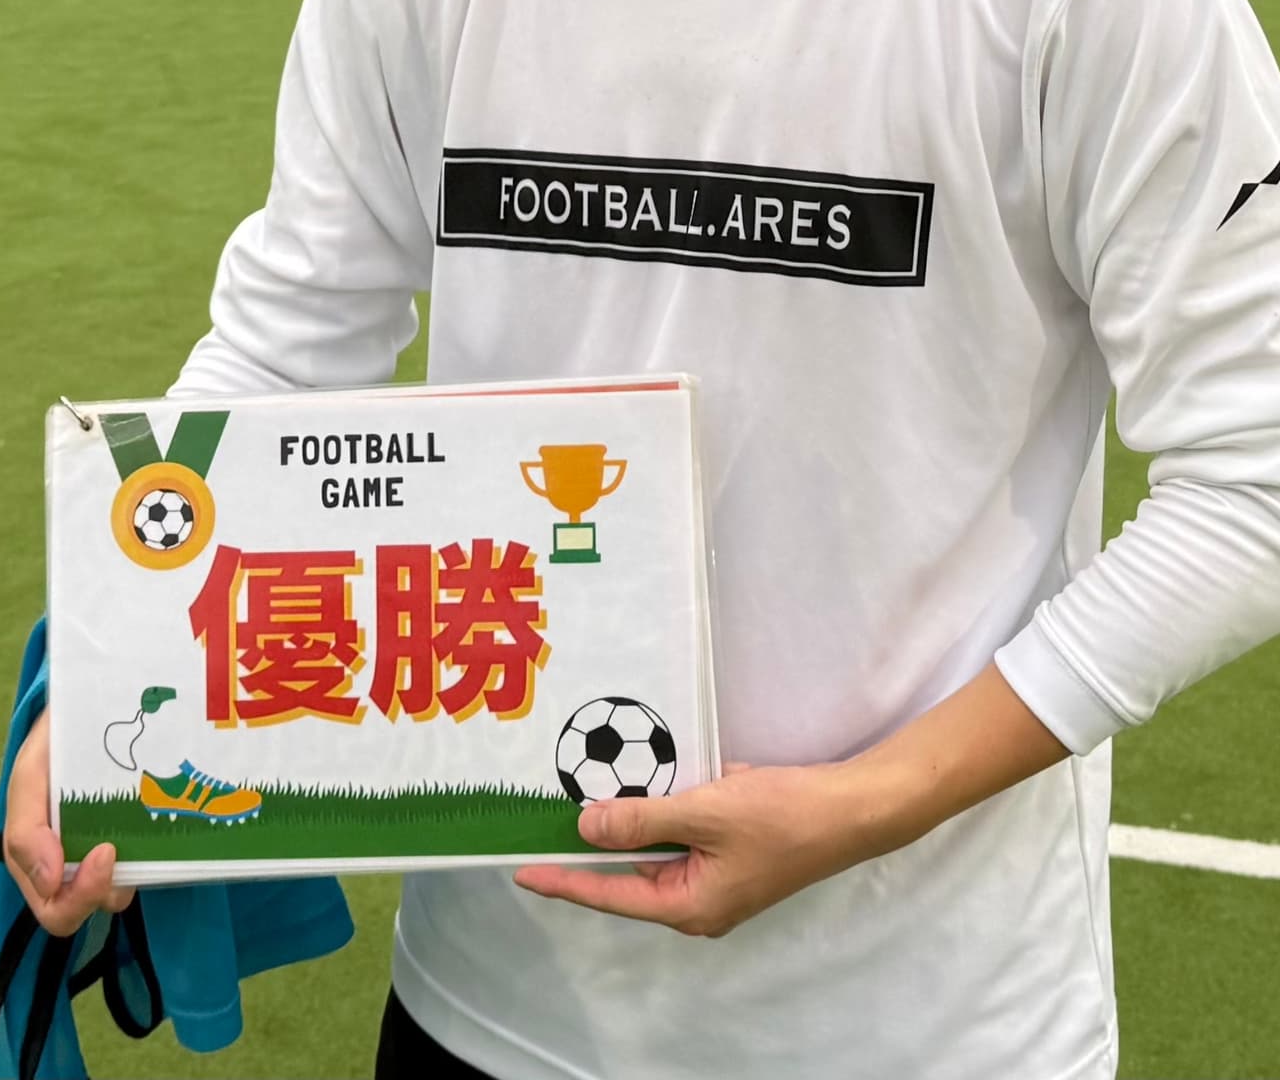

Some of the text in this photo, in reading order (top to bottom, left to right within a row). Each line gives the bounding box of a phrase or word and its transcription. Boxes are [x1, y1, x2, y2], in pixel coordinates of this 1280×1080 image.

[499, 176, 853, 251] FOOTBALL.ARES
[280, 432, 446, 466] FOOTBALL
[320, 477, 405, 509] GAME
[188, 537, 553, 729] 優勝
